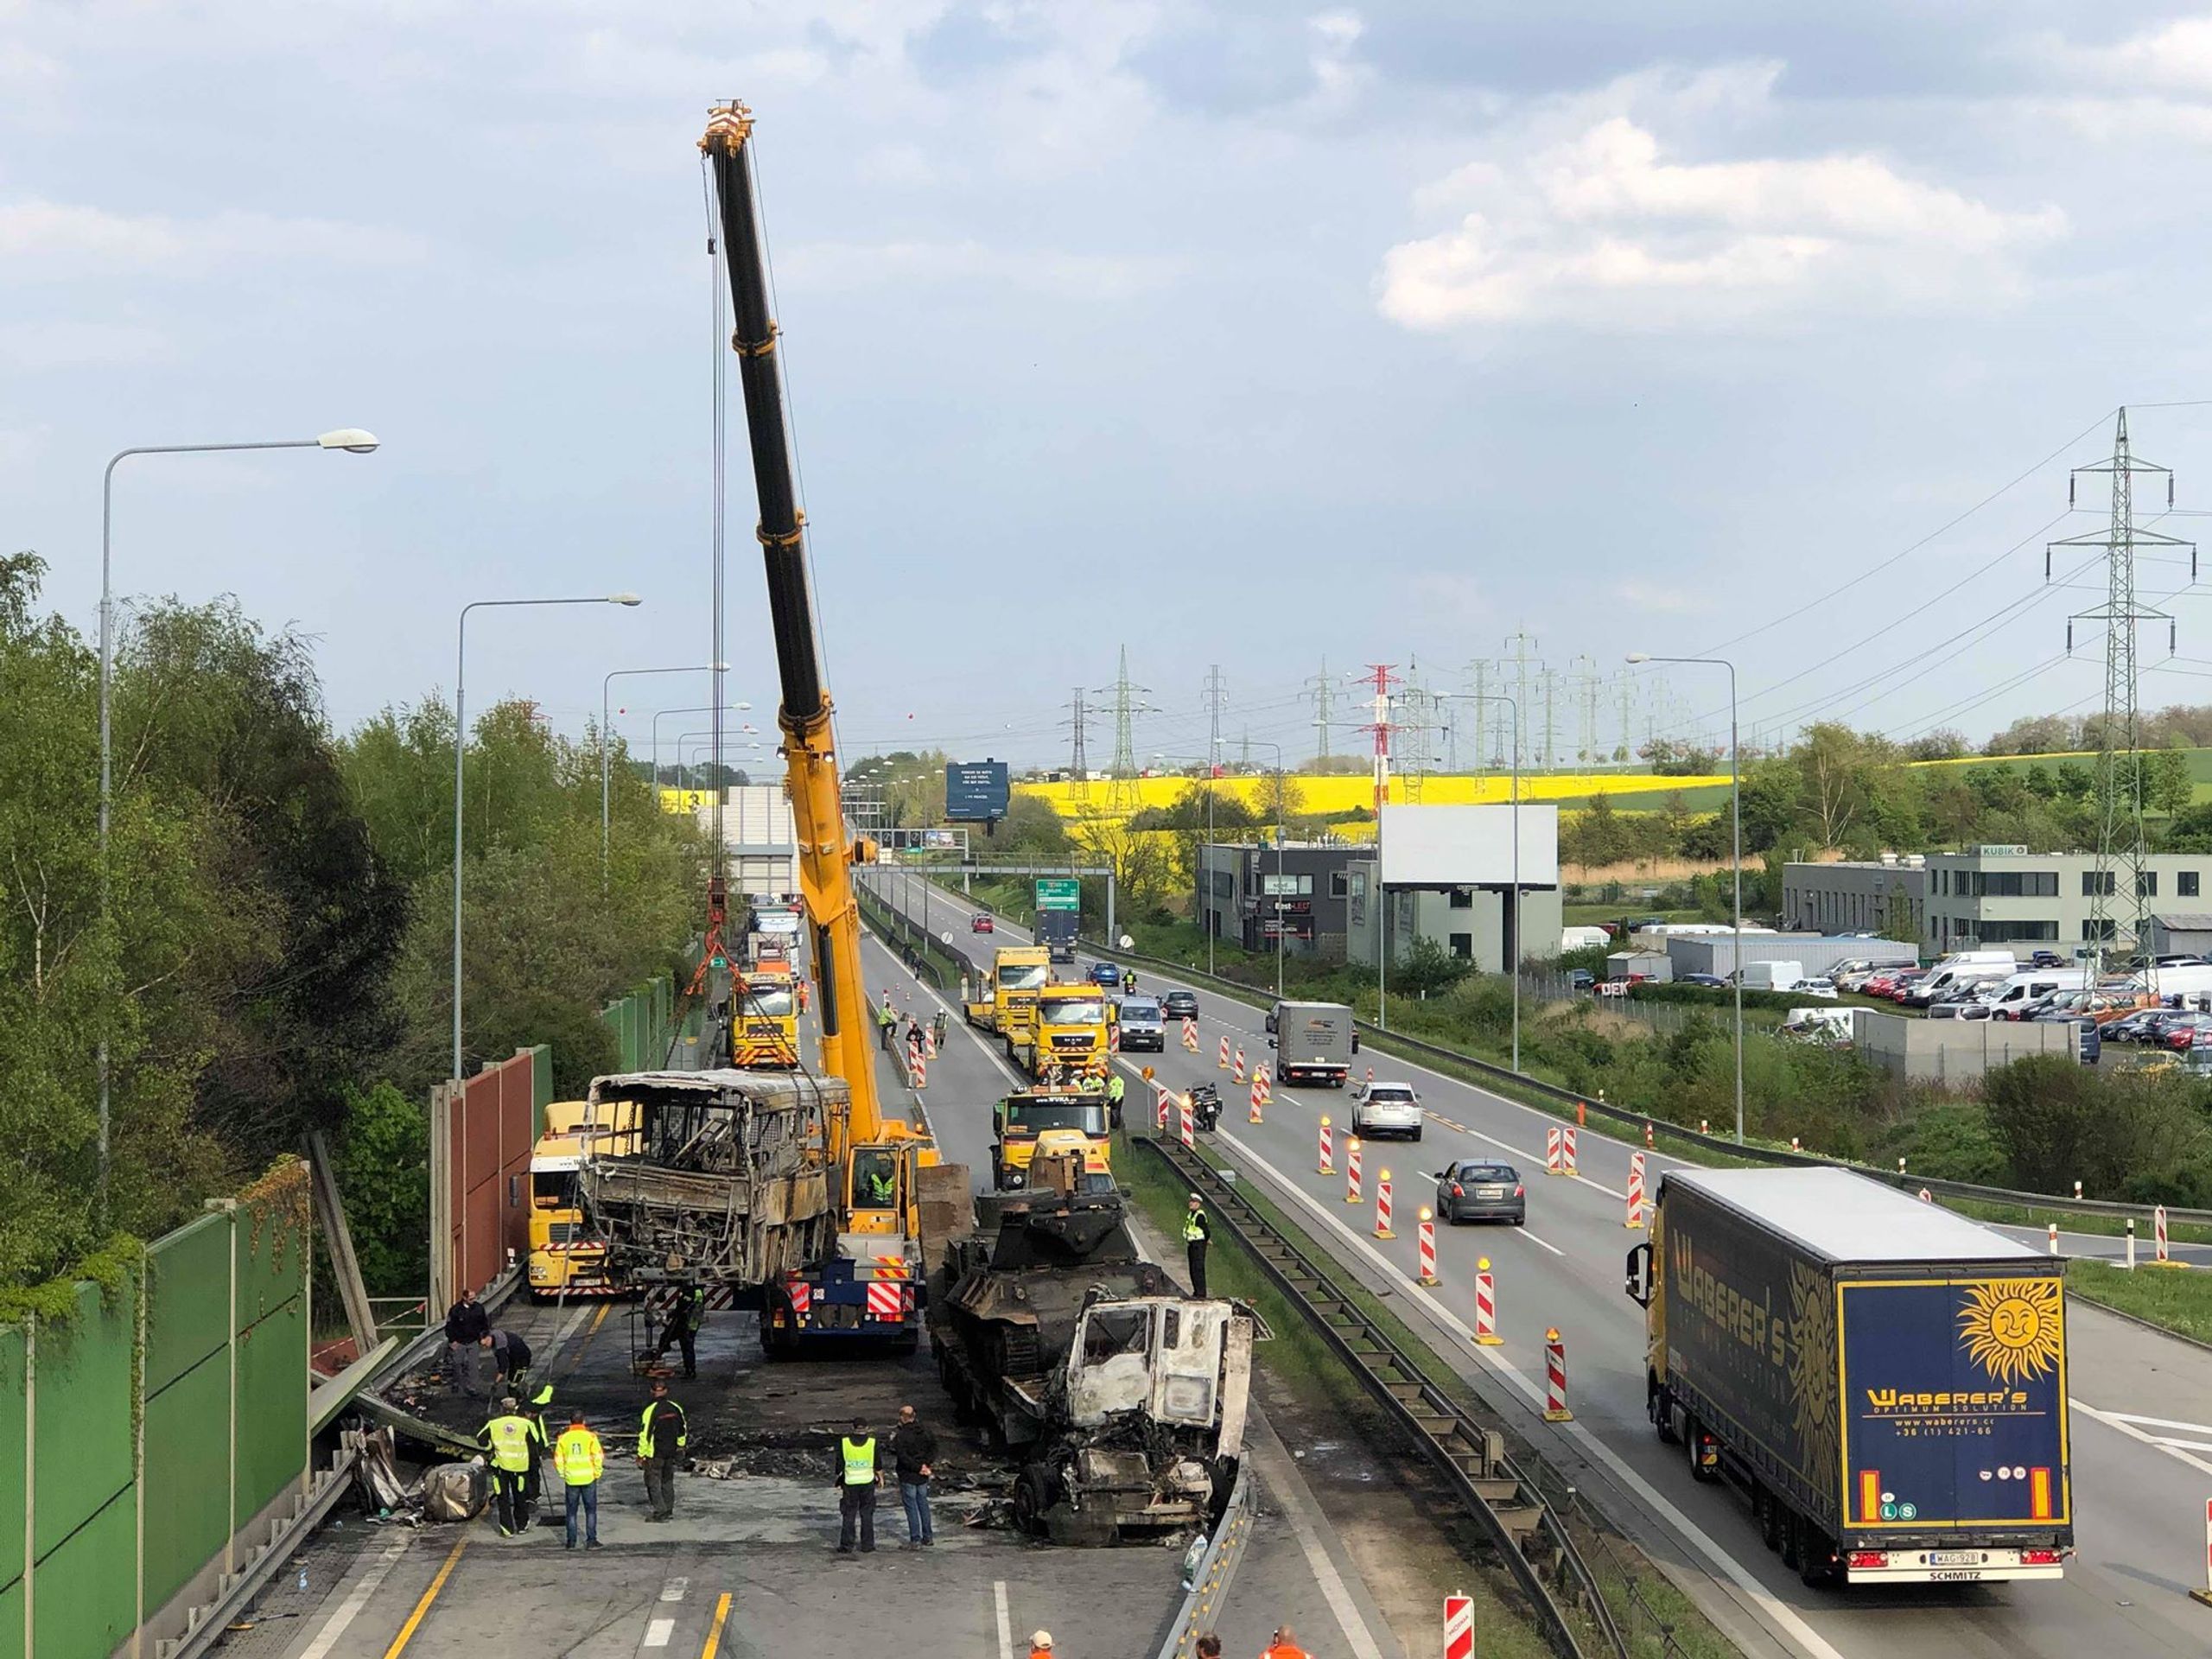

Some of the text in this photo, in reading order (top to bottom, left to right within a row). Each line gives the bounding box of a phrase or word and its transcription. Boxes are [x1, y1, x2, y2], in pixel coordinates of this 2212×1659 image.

[1867, 1387, 2027, 1406] WABERER'S
[1873, 1403, 2028, 1414] OPTIMUM SOLUTION
[1929, 1571, 1981, 1580] SCHMITZ
